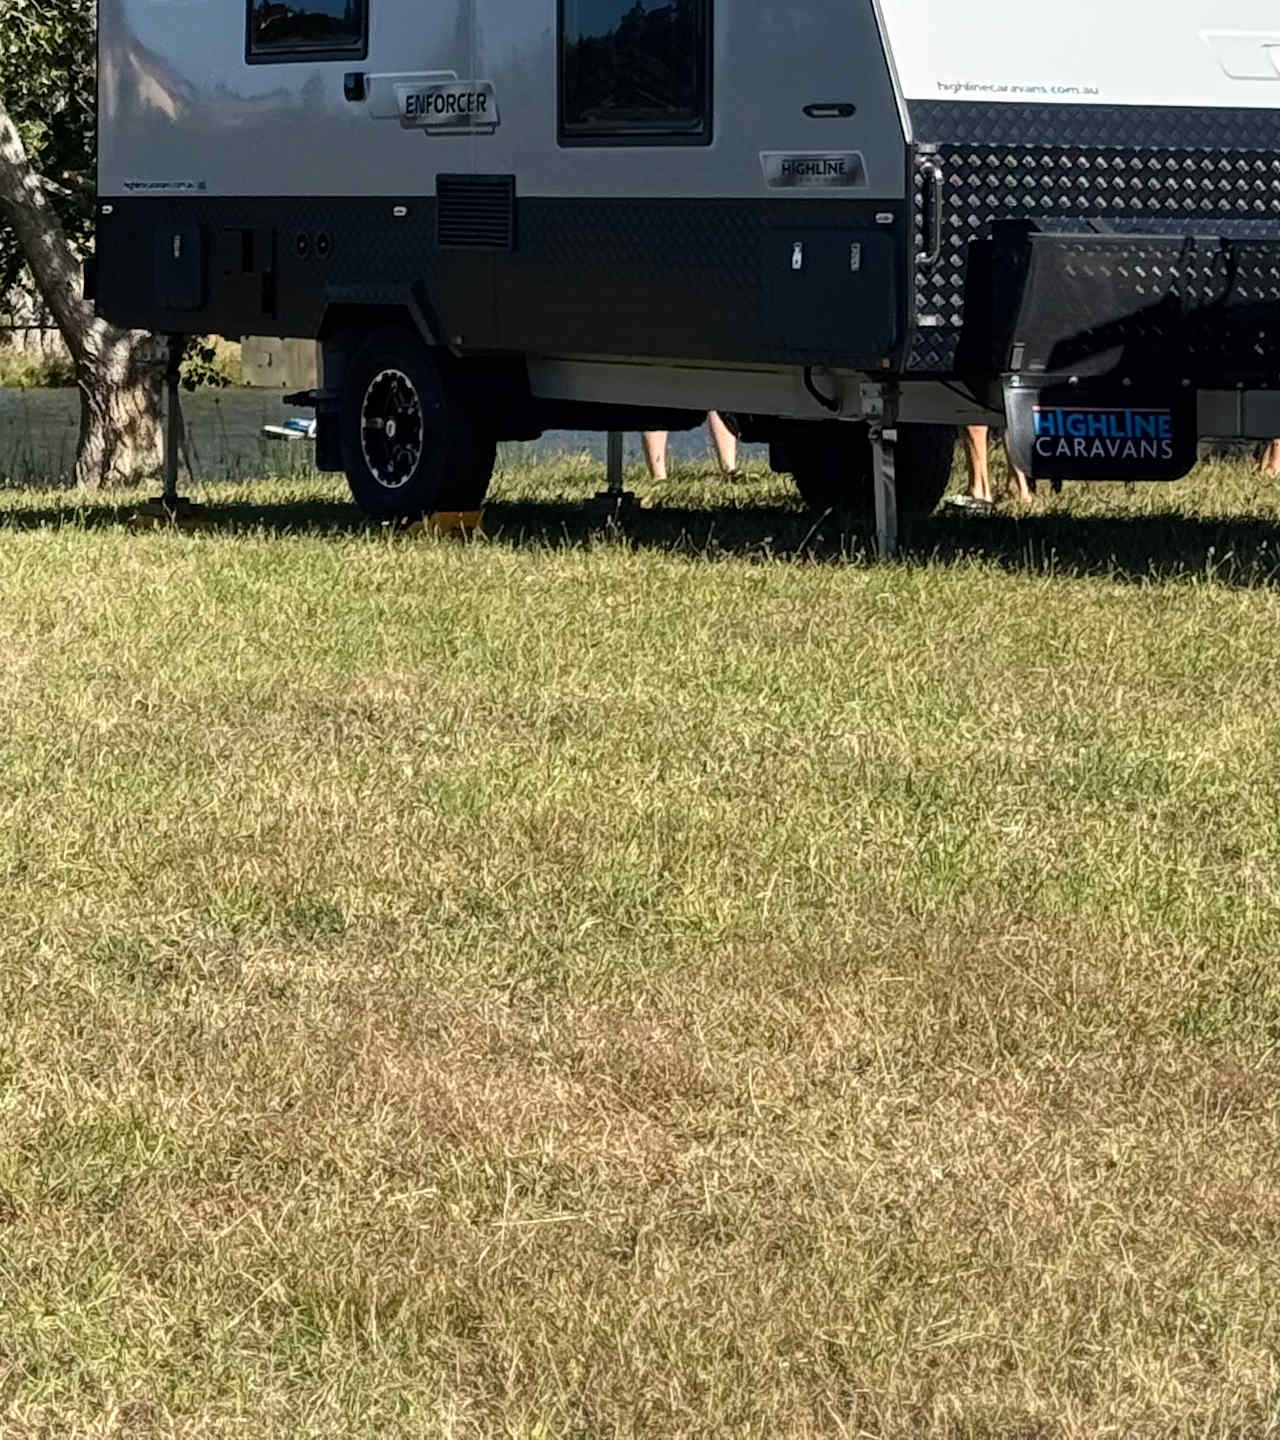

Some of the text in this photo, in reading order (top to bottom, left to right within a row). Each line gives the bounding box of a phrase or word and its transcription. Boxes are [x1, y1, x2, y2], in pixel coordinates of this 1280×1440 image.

[405, 92, 487, 114] ENFORCER
[781, 160, 847, 176] HIGHLINE
[1032, 408, 1172, 438] HIGHLINE
[1036, 437, 1174, 459] CARAVANS
